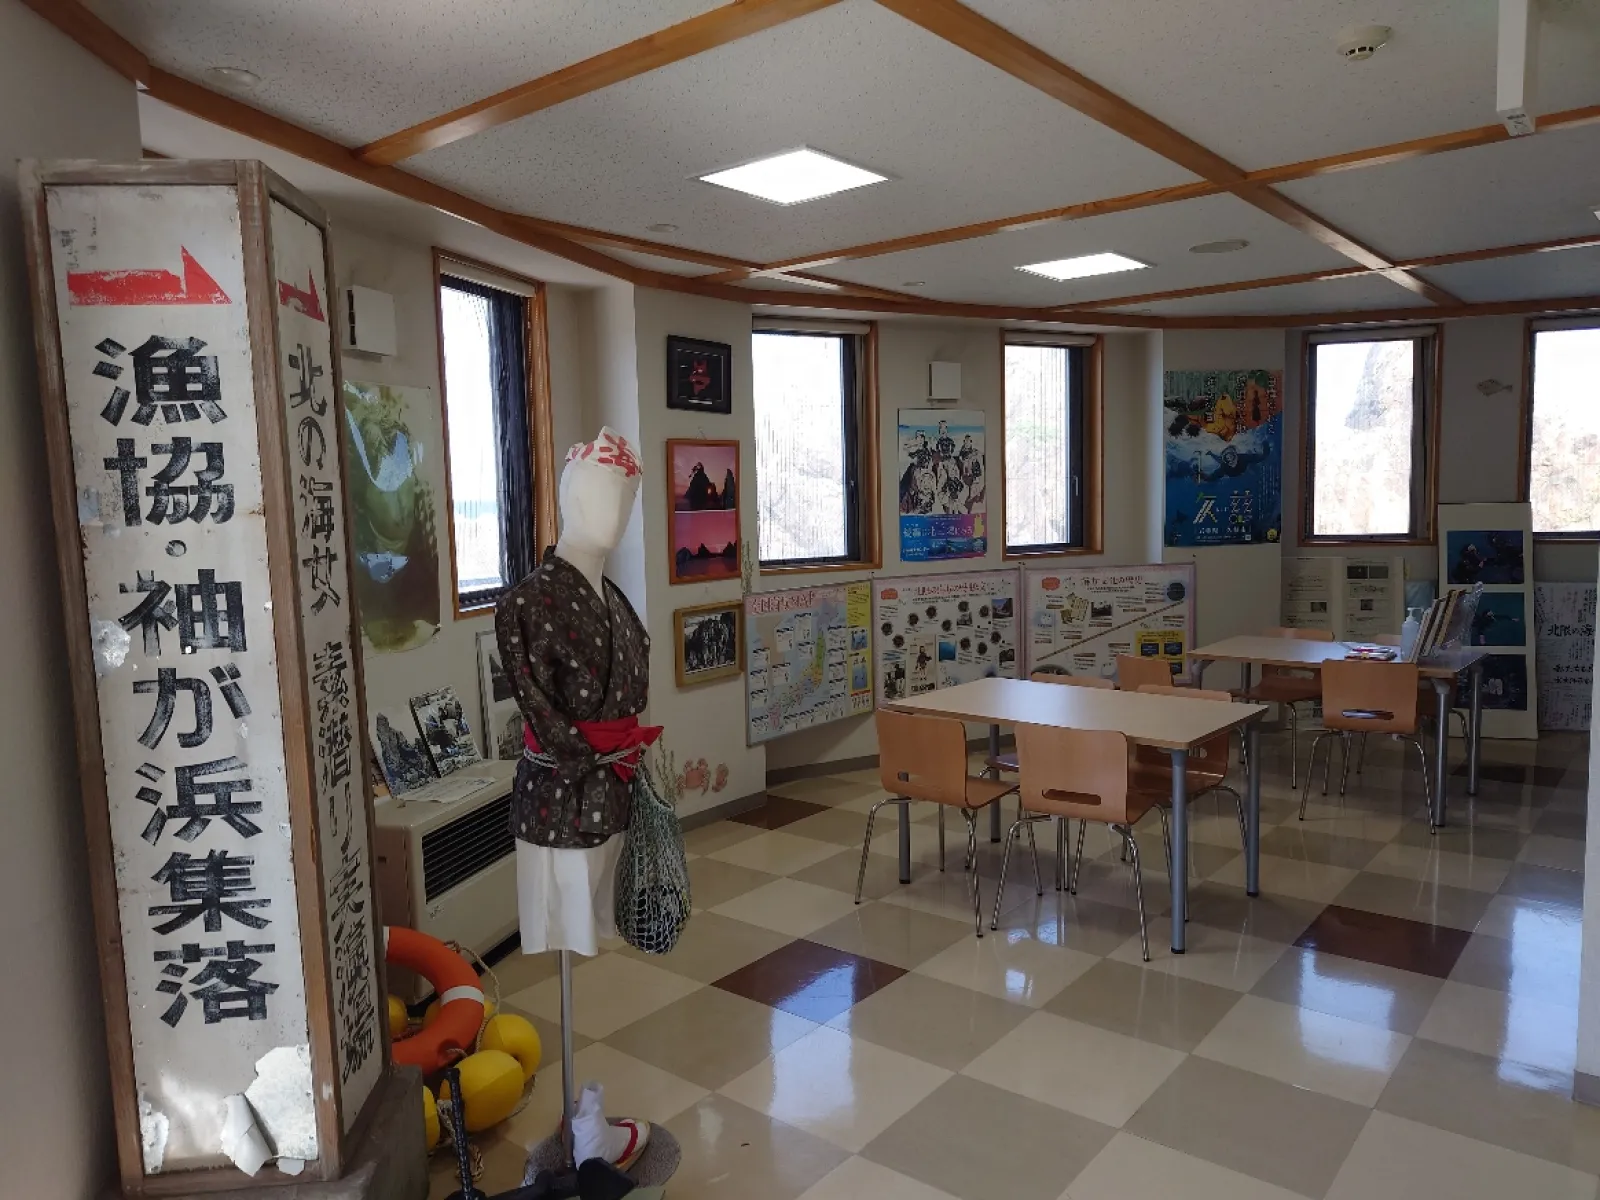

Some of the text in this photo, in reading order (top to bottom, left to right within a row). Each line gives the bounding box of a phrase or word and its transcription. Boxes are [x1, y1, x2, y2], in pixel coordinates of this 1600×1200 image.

[93, 334, 279, 1027] 漁協・袖が浜集落
